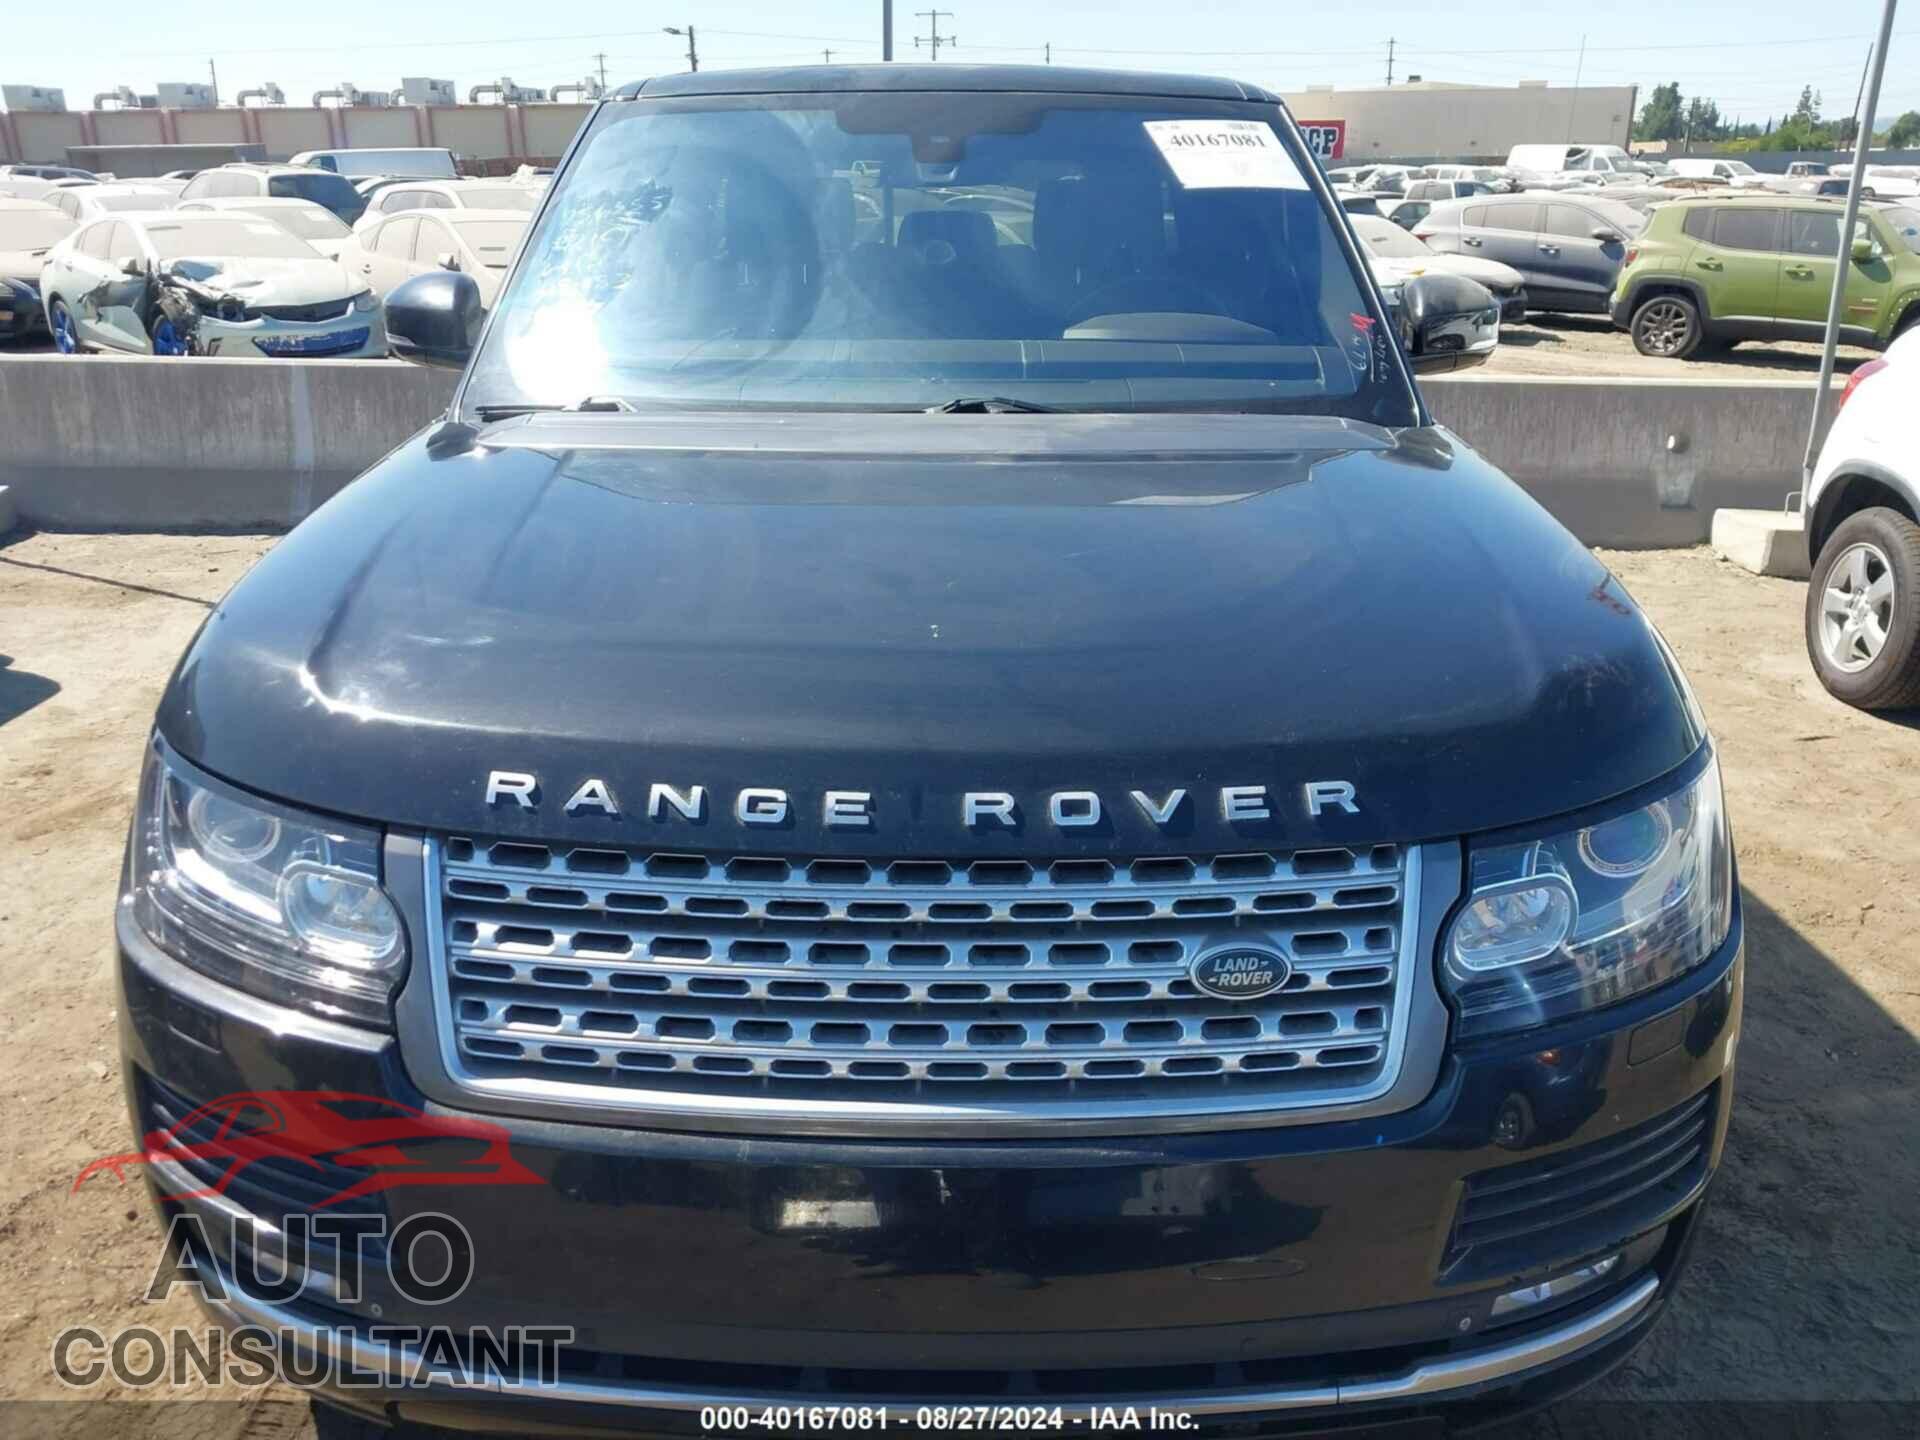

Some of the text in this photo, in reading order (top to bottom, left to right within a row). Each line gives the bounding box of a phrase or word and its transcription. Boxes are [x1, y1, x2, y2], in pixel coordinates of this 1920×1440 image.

[1170, 133, 1266, 148] 40167081
[1301, 128, 1337, 155] CP
[485, 770, 1360, 826] RANGE ROVER
